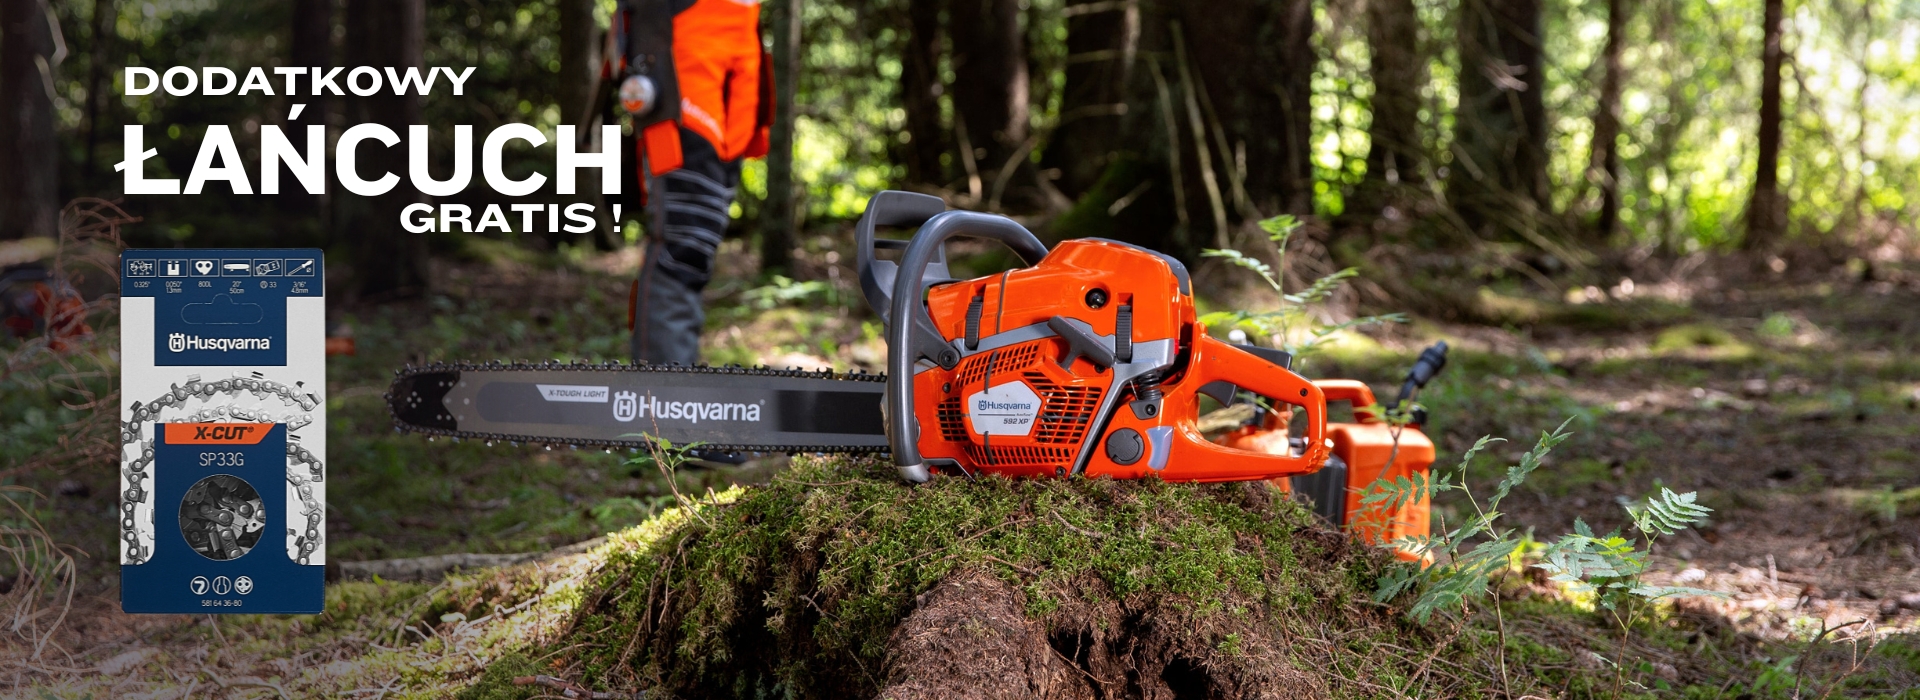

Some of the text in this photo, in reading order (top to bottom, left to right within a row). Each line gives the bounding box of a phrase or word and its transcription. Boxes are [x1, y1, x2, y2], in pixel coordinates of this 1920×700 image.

[187, 335, 271, 352] Husqvarna
[548, 389, 606, 399] X-TOUGH LIGHT
[638, 395, 761, 424] Husqvarna
[987, 401, 1031, 411] Husqvarna
[199, 452, 244, 467] SP33G
